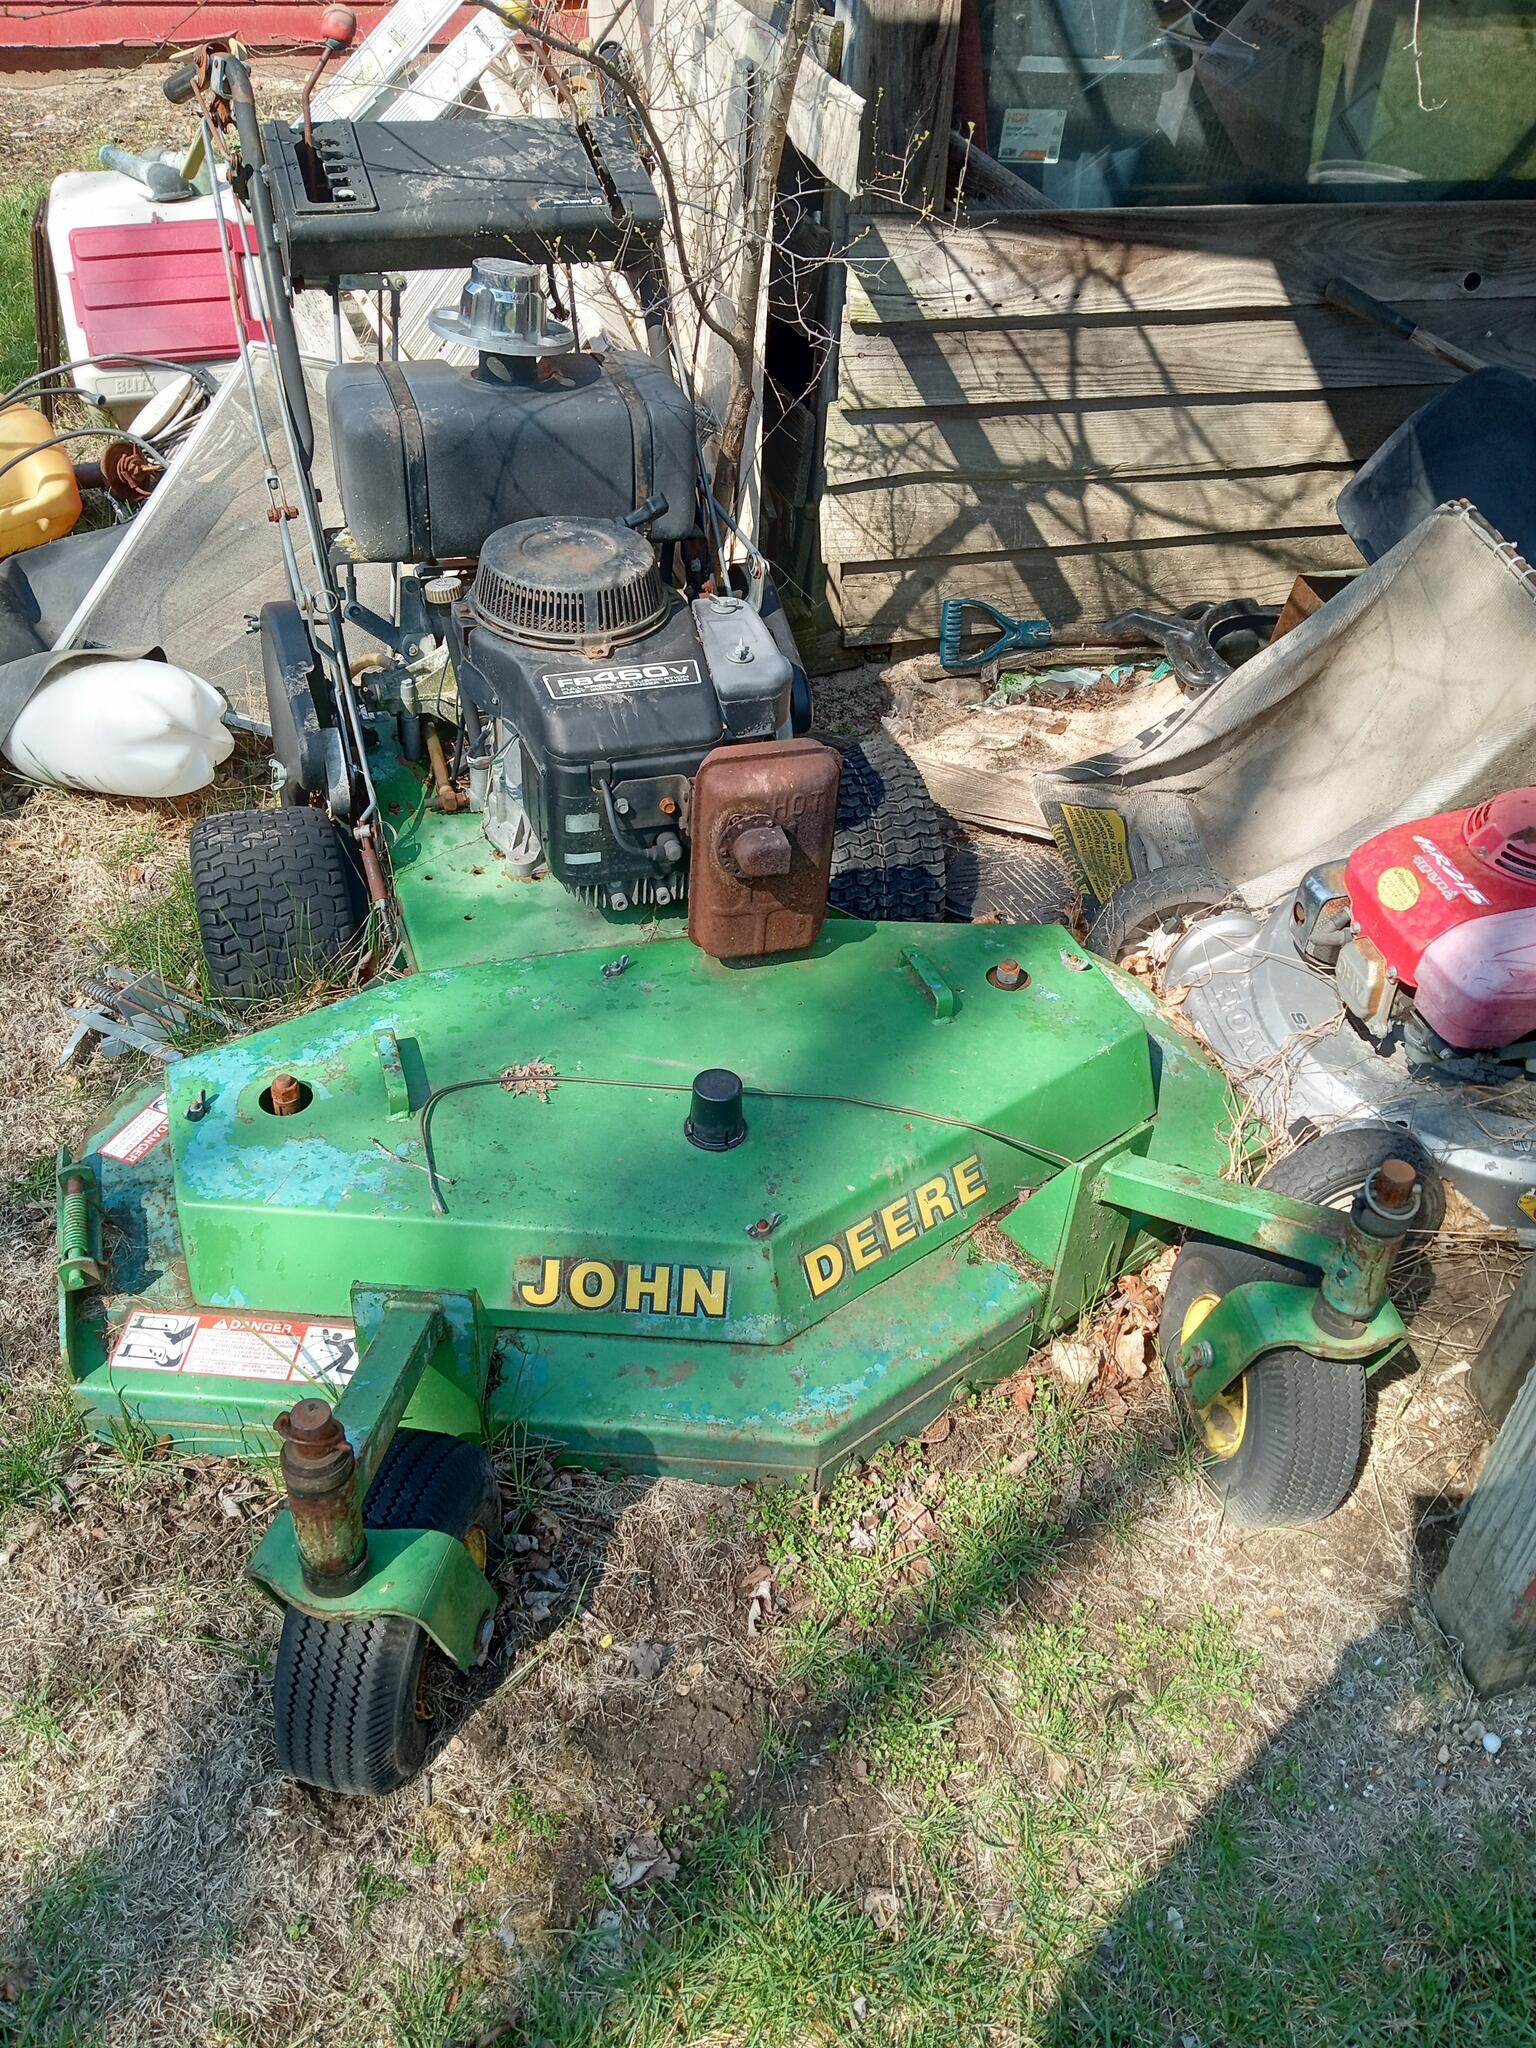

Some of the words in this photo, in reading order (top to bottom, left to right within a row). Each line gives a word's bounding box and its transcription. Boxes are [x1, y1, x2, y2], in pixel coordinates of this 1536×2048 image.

[115, 375, 155, 394] BLITZ
[1412, 854, 1458, 902] HONDA
[125, 1124, 168, 1162] DANGER
[519, 1257, 729, 1318] JOHN
[803, 1154, 988, 1299] DEERE
[230, 1319, 292, 1333] DANGER
